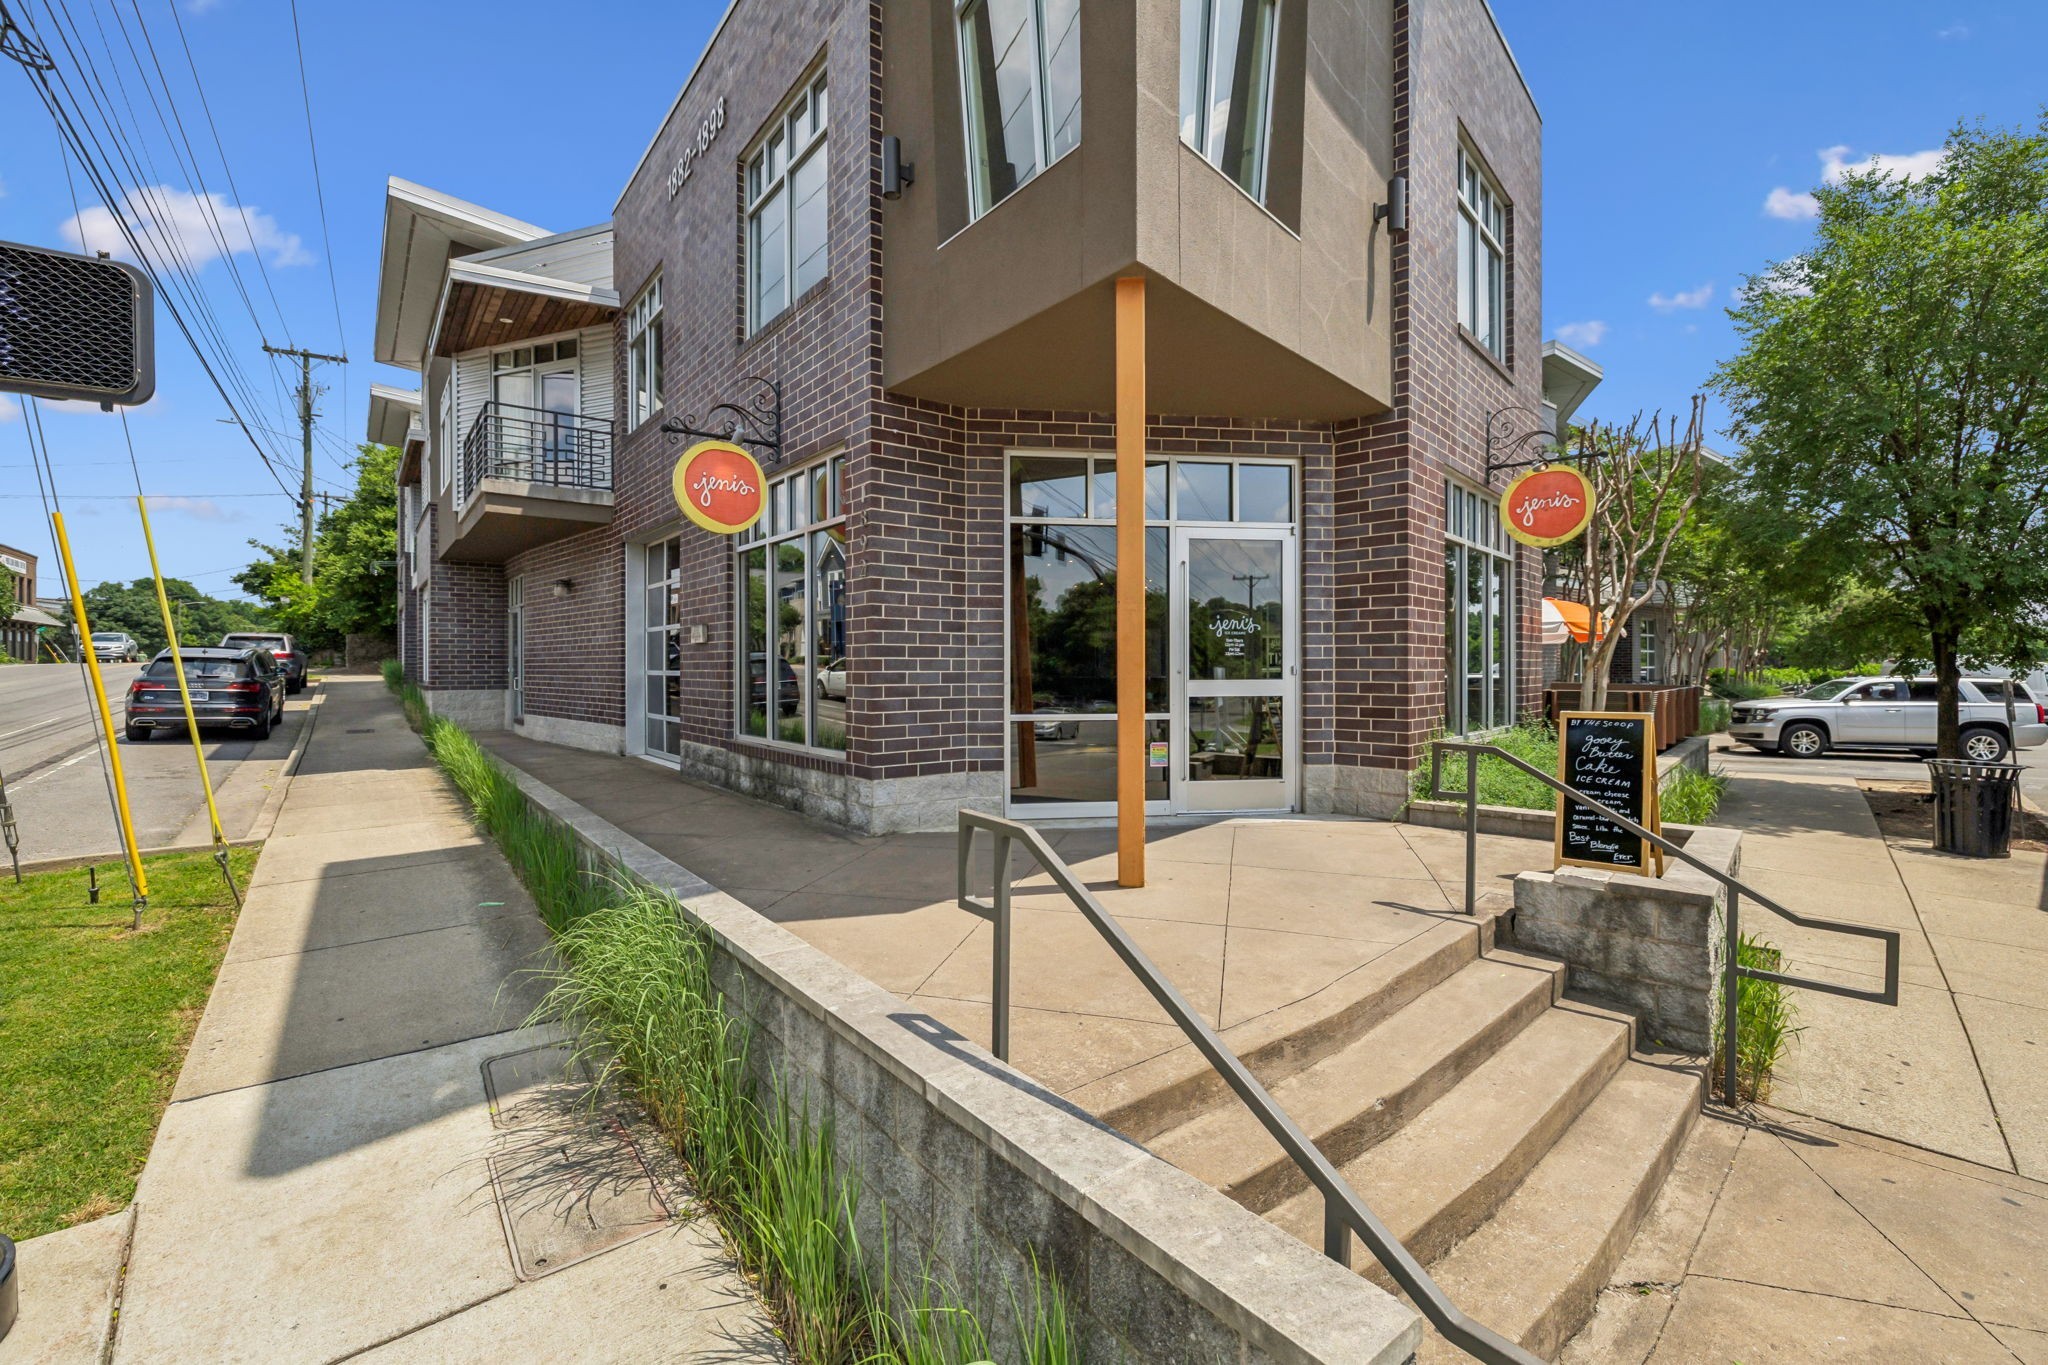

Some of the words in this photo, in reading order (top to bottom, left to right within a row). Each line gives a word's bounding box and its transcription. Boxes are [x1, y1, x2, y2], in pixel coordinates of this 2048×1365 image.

[667, 96, 724, 201] 1882-1898
[1208, 614, 1261, 637] jeni's
[1584, 719, 1600, 727] THE
[1602, 720, 1634, 728] SCOOP
[1589, 746, 1634, 759] Butter
[1575, 756, 1621, 774] Cake
[1575, 775, 1593, 783] ICE
[1595, 777, 1631, 788] CREAM
[1604, 790, 1630, 798] cheese
[1568, 831, 1591, 841] Best
[1590, 840, 1619, 850] Blondie
